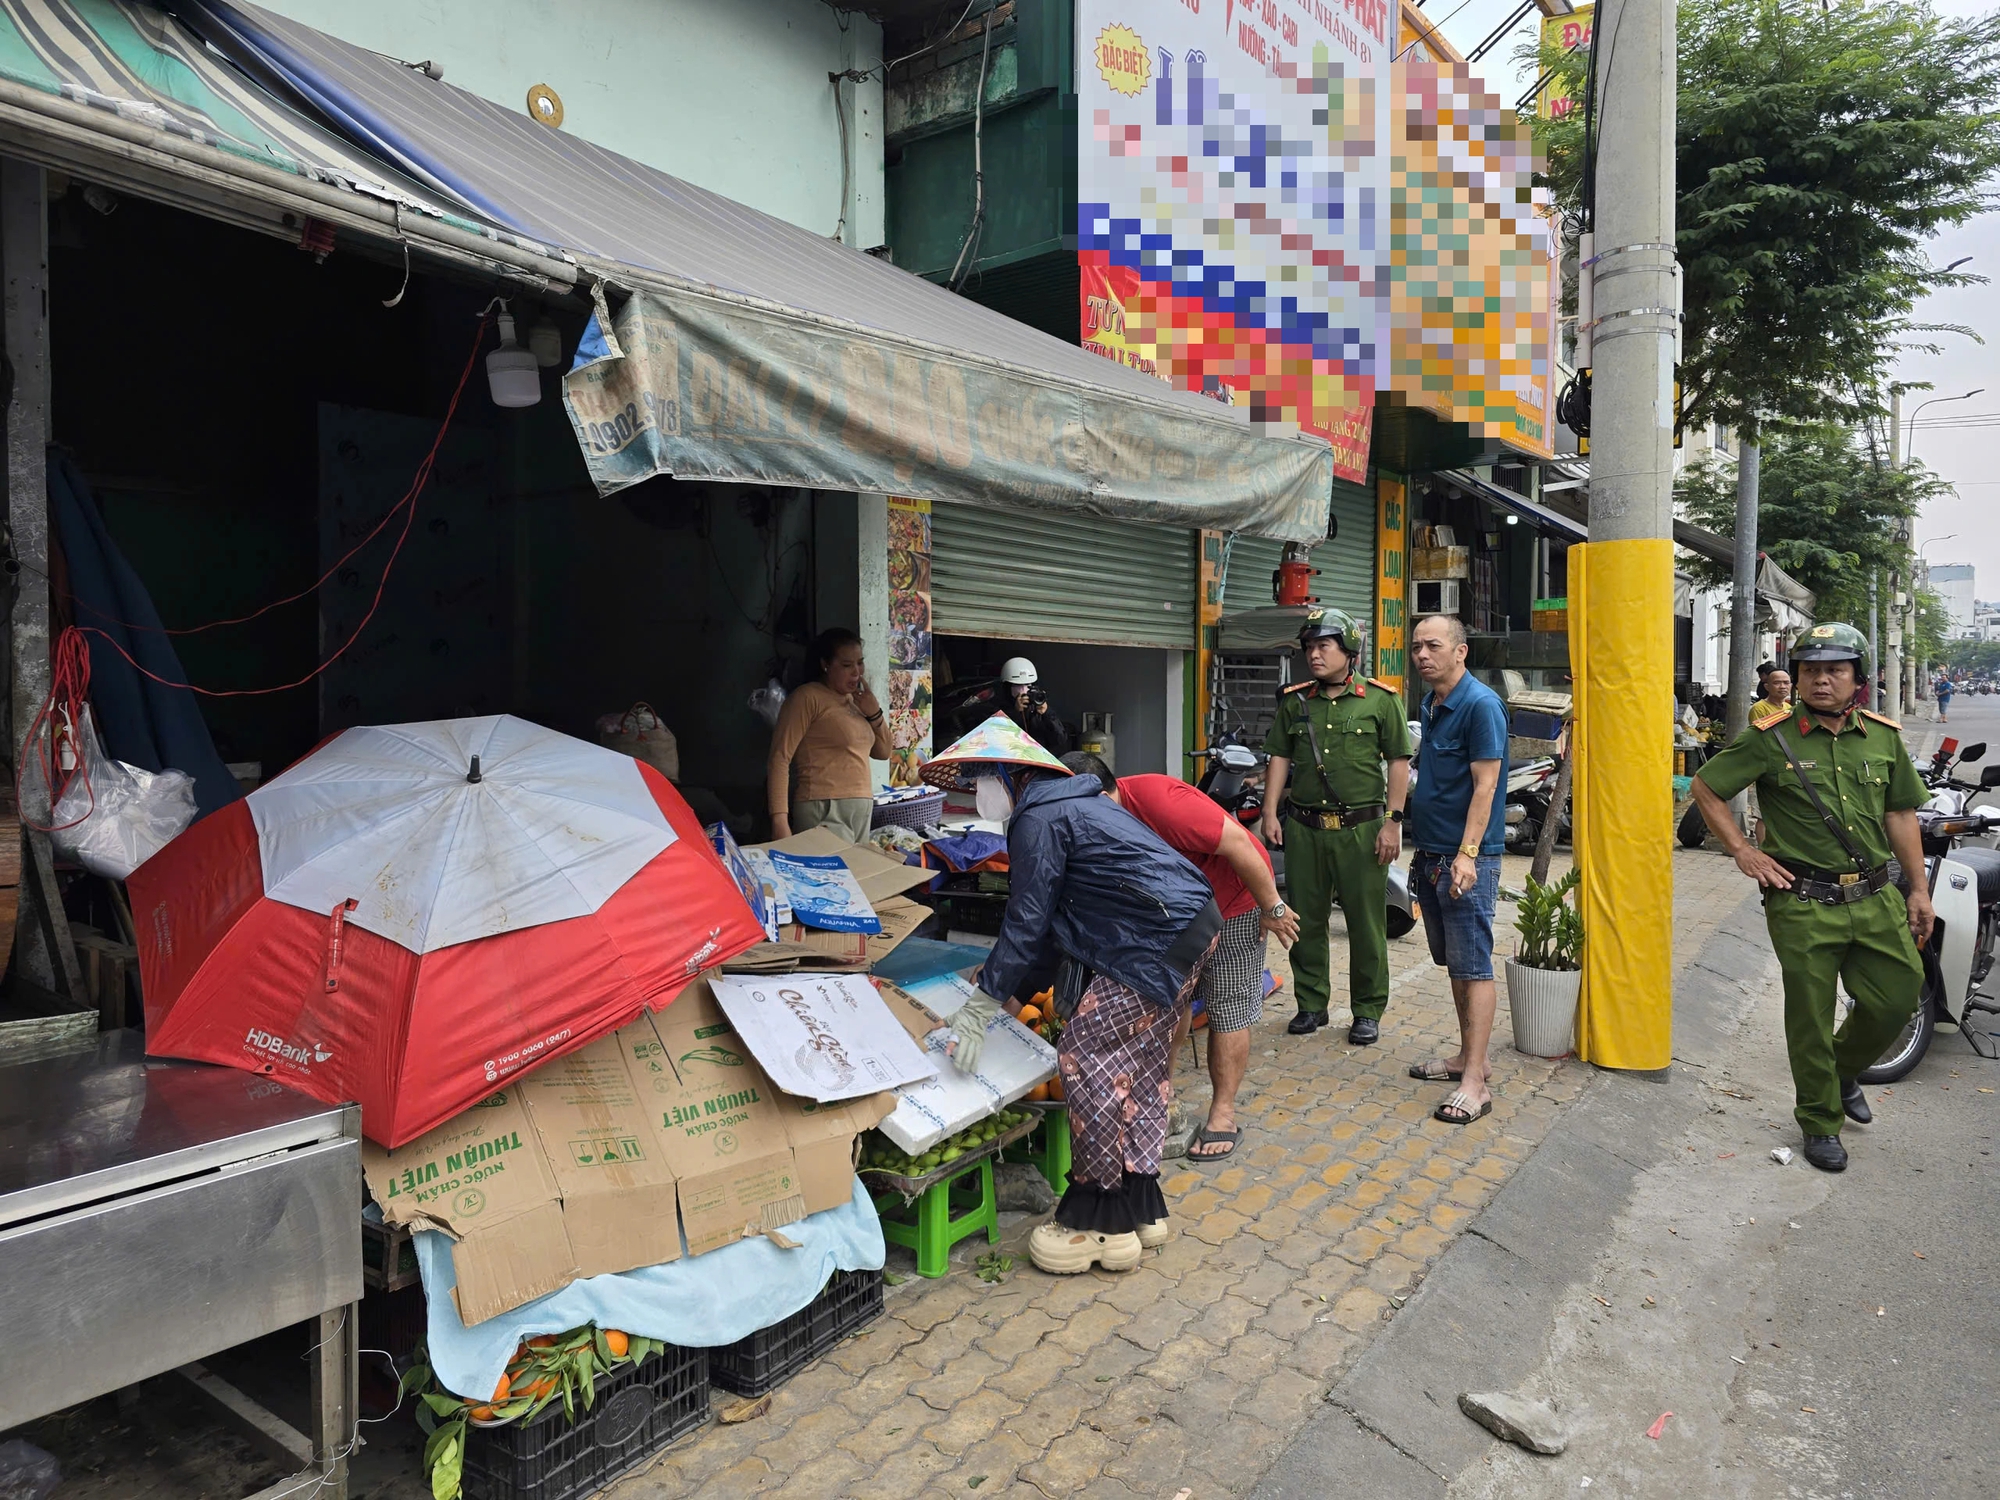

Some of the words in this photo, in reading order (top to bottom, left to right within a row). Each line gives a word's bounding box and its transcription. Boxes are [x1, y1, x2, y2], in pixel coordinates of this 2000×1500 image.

[1315, 0, 1358, 57] NHÁNH
[1102, 39, 1122, 76] ĐẶC
[1123, 46, 1143, 81] BIỆT
[1087, 295, 1125, 337] TƯN
[1385, 497, 1401, 531] CÁC
[1384, 549, 1402, 584] LOẠI
[1382, 597, 1403, 634] THỰC
[1380, 637, 1403, 676] PHẨM
[245, 1028, 312, 1065] HDBank
[499, 1051, 520, 1065] 1900
[522, 1041, 544, 1056] 6060
[546, 1028, 571, 1046] (24/7)
[662, 1104, 701, 1129] VIỆT
[703, 1088, 760, 1116] THUẬN
[685, 1121, 718, 1138] CHẤM
[445, 1131, 523, 1175] THUẬN
[387, 1161, 440, 1199] VIỆT
[415, 1179, 461, 1203] CHẤM
[464, 1162, 505, 1185] NƯỚC
